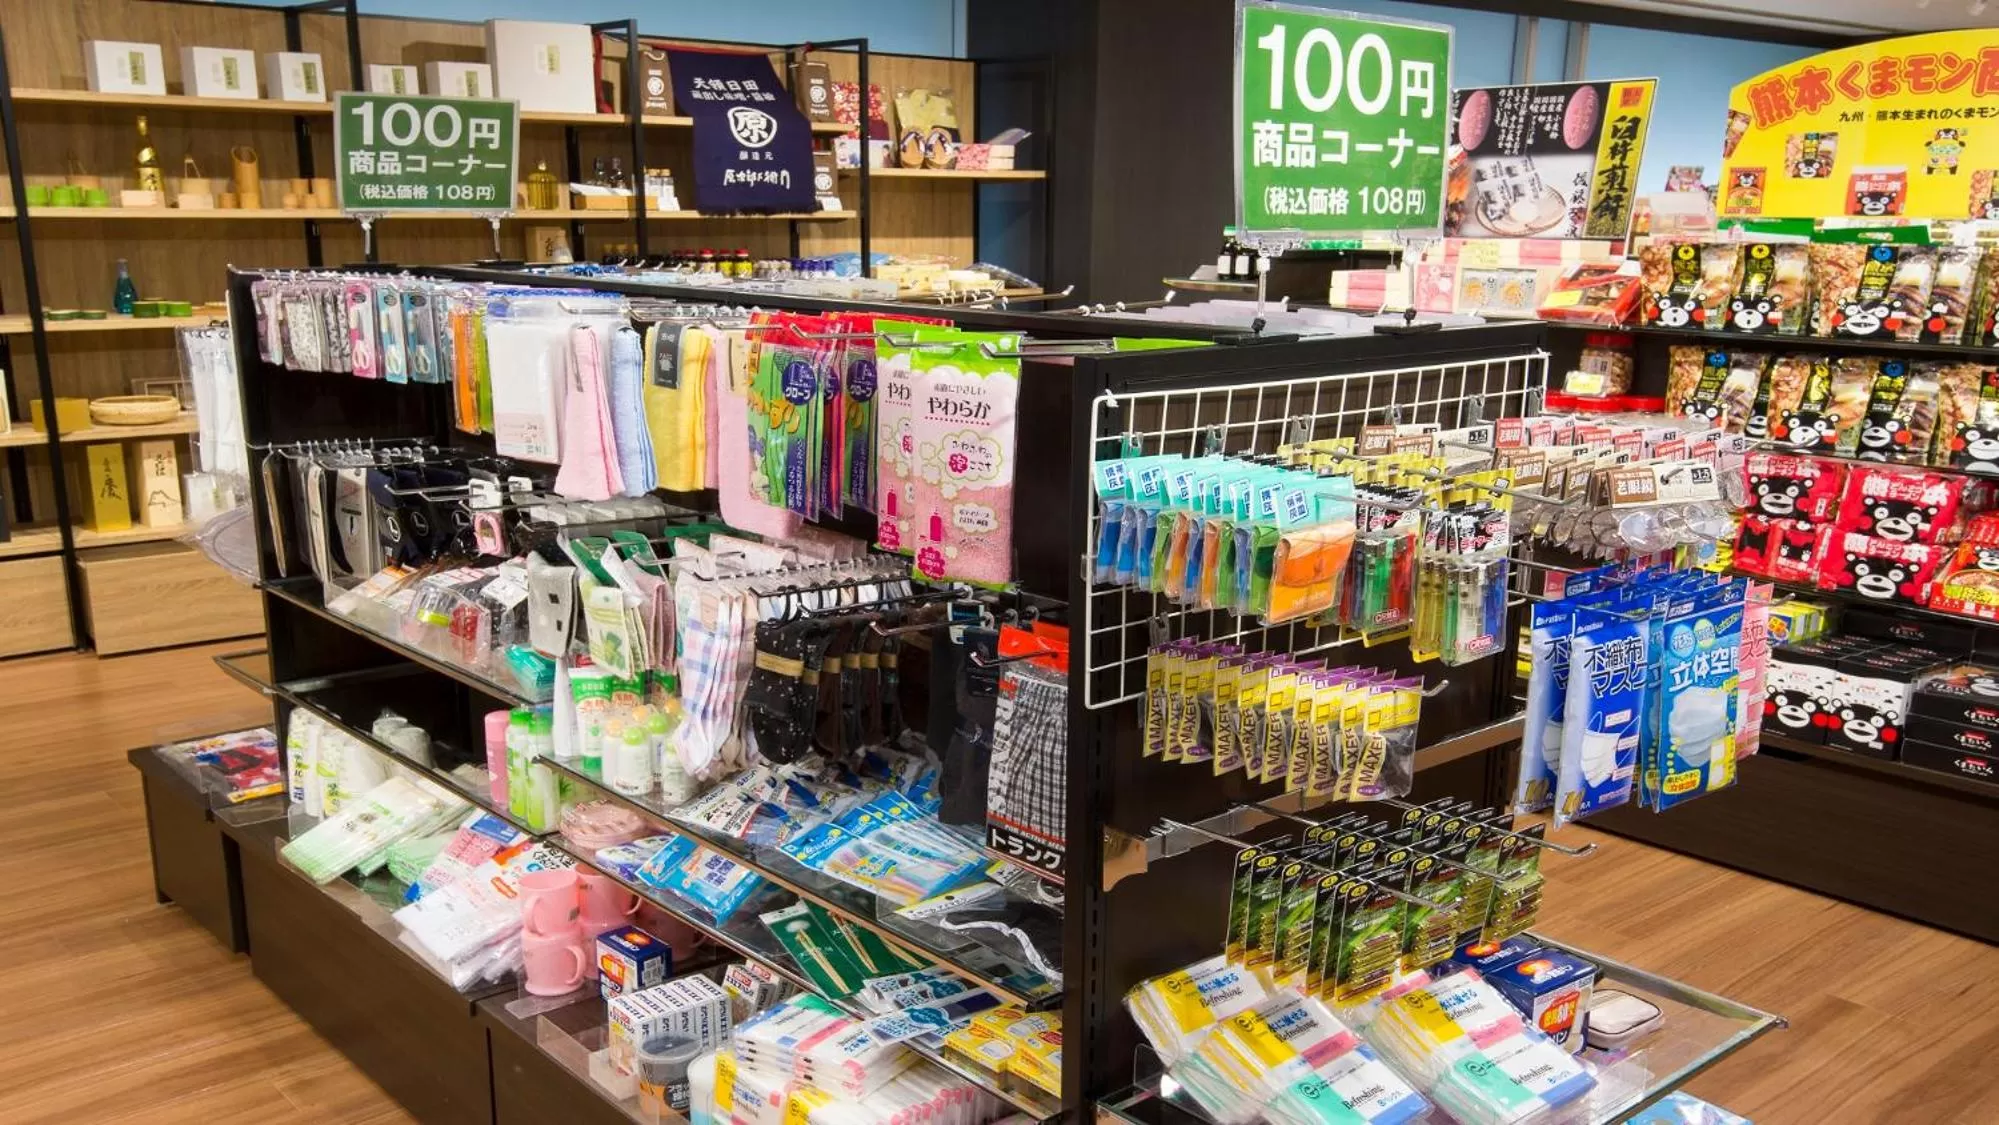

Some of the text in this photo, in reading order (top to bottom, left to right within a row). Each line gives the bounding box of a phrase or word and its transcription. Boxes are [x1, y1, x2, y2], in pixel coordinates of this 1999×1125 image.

[693, 77, 760, 92] 天領日田
[1258, 24, 1435, 118] 100円
[351, 101, 500, 149] 100円
[734, 112, 768, 143] 原
[1252, 119, 1440, 169] 商品コーナー
[348, 150, 507, 176] 商品コーナー
[359, 184, 496, 202] (税込価格 108円)
[1264, 186, 1426, 215] (税込価格 108円)
[927, 397, 992, 420] やわらか
[1583, 637, 1646, 672] 不織布
[1590, 659, 1648, 699] マスク
[1181, 695, 1196, 743] MAXER
[1218, 704, 1233, 756] MAXER
[1267, 712, 1283, 766] MAXER
[1293, 719, 1309, 773] MAXER
[1315, 725, 1331, 780] MAXER
[1359, 732, 1384, 784] MAXER
[991, 829, 1063, 872] トランク
[1274, 1019, 1320, 1044] Refreshing
[1341, 1082, 1387, 1113] Refreshing
